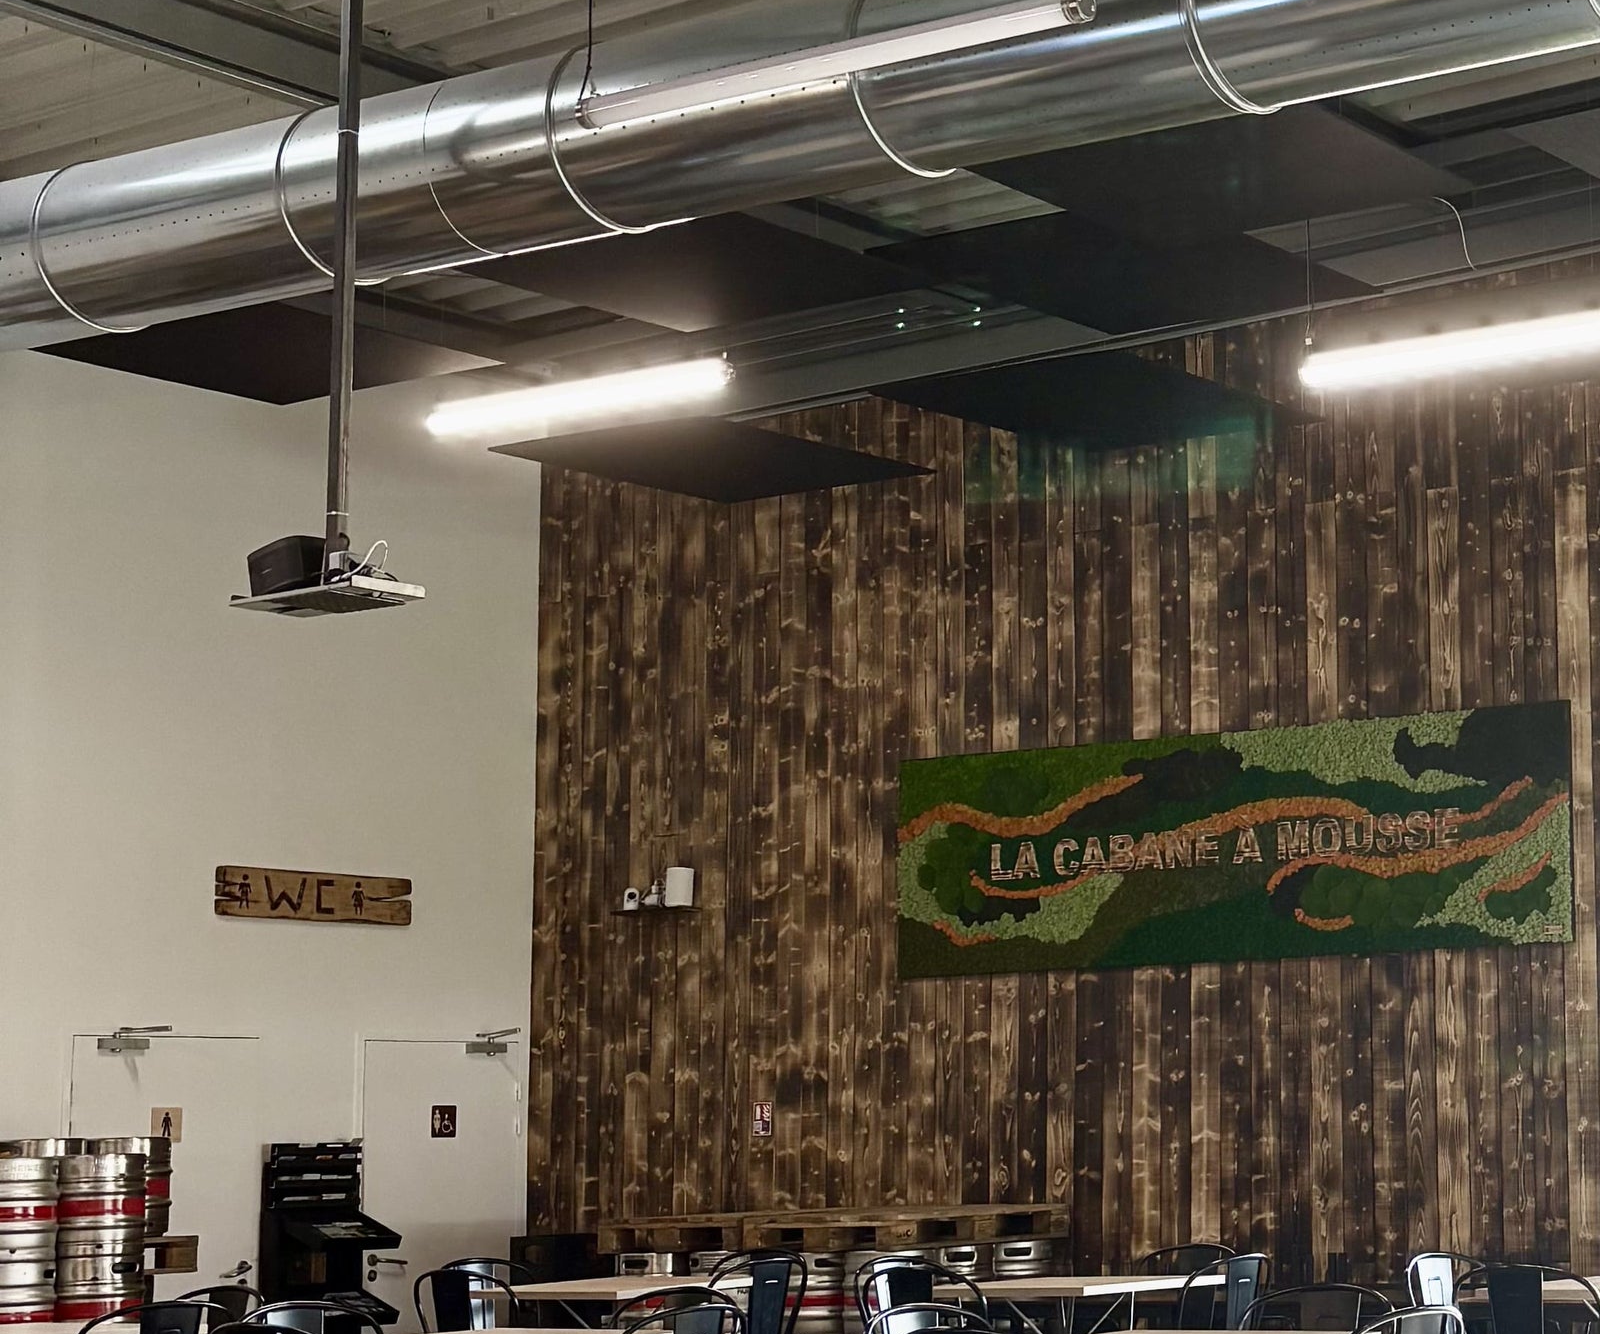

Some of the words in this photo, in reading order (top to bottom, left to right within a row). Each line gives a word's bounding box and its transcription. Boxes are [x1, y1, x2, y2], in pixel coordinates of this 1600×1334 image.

[991, 842, 1040, 880] LA
[1053, 829, 1219, 876] CABANE
[1277, 808, 1461, 860] MOUSSE
[264, 875, 335, 915] WC
